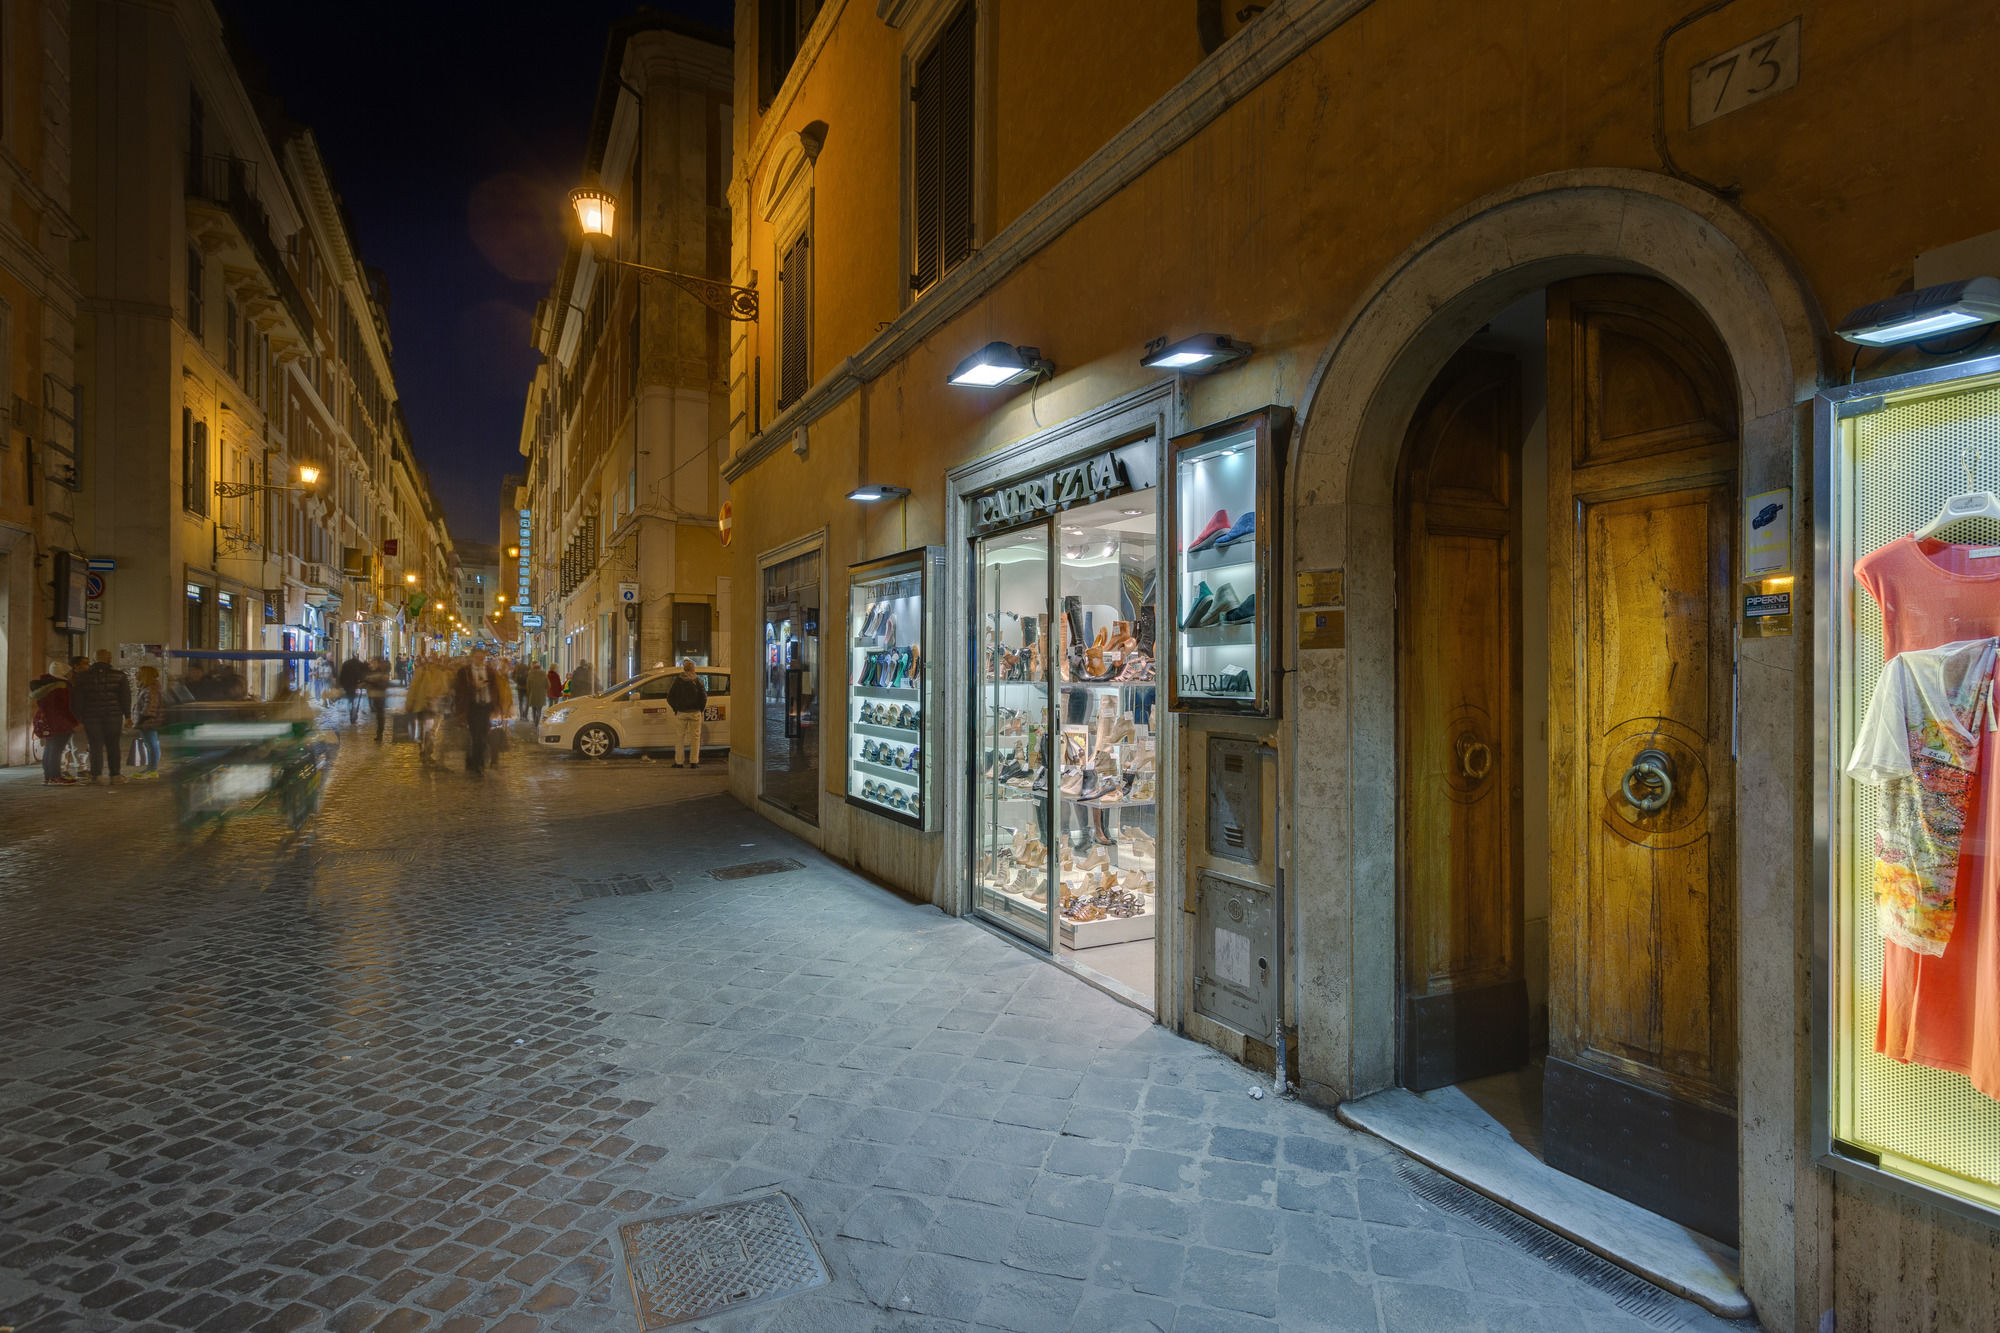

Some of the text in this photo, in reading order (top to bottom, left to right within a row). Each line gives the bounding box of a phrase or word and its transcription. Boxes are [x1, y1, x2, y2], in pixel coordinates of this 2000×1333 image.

[1705, 35, 1781, 113] 73
[976, 452, 1126, 527] PATRIZIA
[1746, 594, 1789, 606] PIPERNO
[1181, 673, 1254, 693] PATRIZIA
